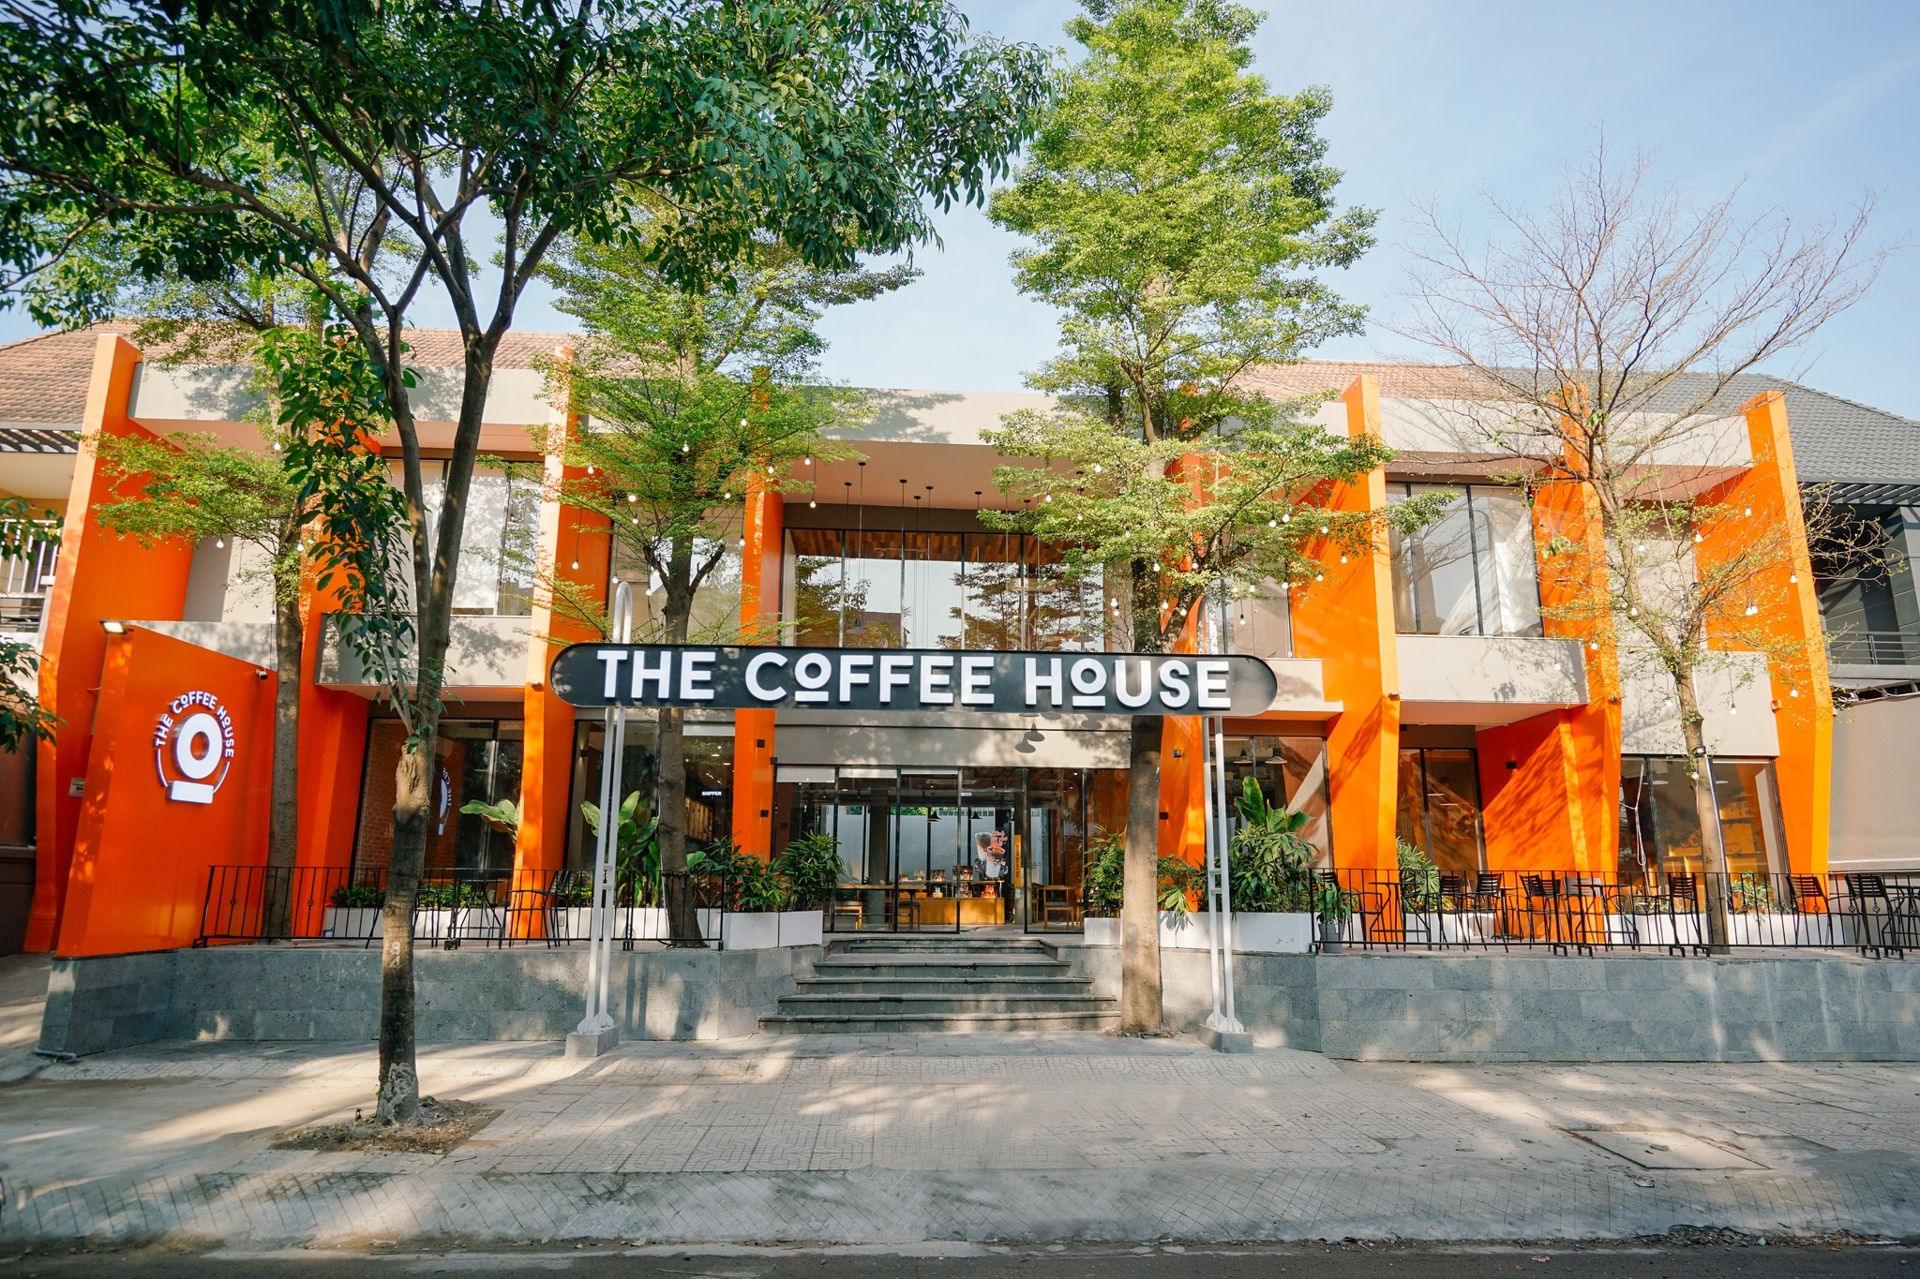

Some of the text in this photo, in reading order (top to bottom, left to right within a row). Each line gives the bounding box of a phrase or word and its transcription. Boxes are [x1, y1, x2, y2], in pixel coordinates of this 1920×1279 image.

[597, 650, 1232, 708] THE COFFEE HOUSE
[154, 690, 235, 758] THE COFFEE HOUSE
